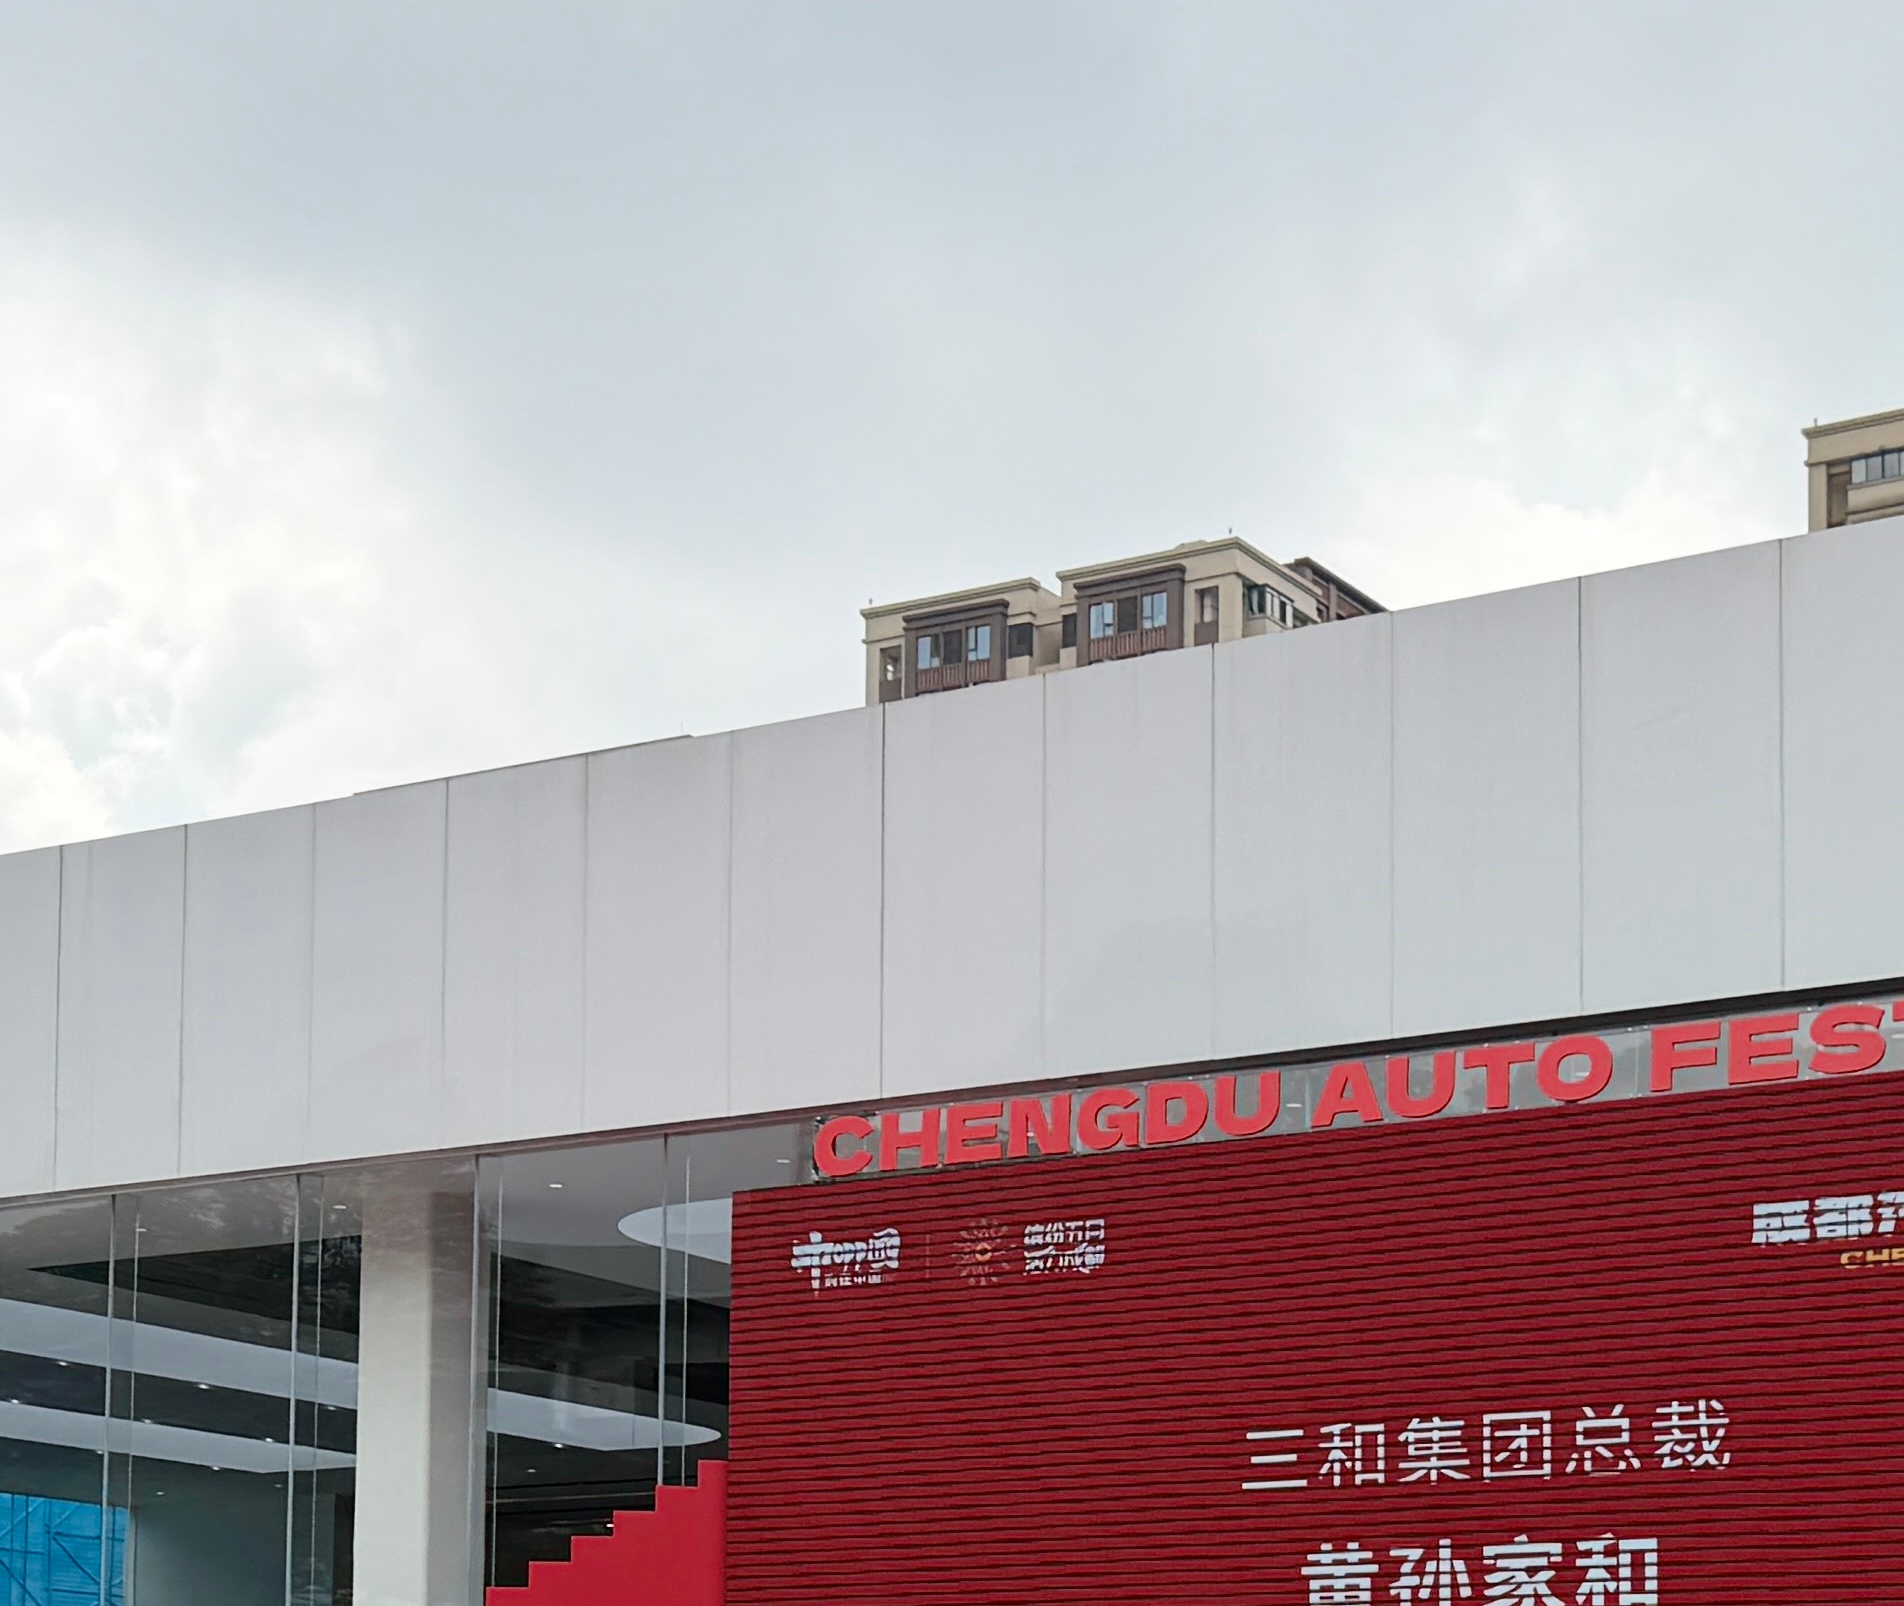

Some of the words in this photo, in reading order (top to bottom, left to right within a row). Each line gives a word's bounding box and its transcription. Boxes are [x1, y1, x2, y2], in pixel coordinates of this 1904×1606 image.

[812, 1070, 1282, 1178] CHENGDU
[1311, 1034, 1614, 1128] AUTO
[1241, 1398, 1731, 1490] 三和集团总裁
